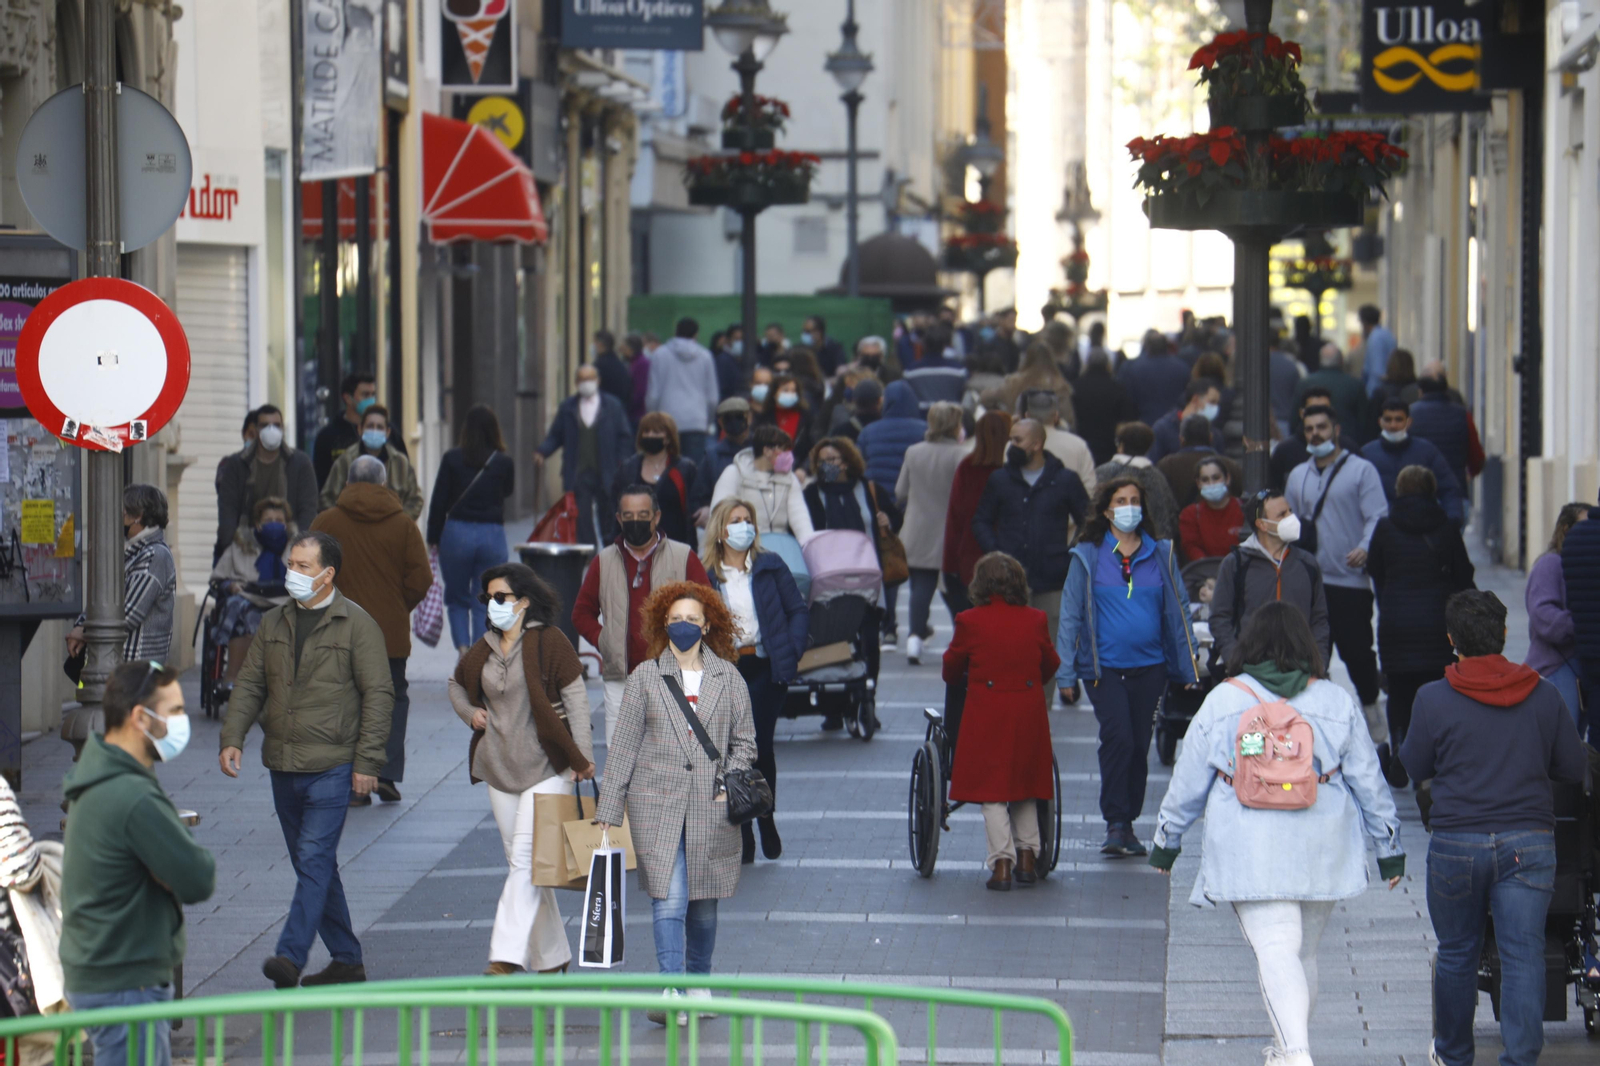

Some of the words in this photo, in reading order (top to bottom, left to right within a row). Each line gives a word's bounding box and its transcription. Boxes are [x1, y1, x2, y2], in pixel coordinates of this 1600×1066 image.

[1373, 6, 1481, 44] Ulloa
[311, 45, 339, 164] MATILDE
[12, 281, 47, 299] artículos
